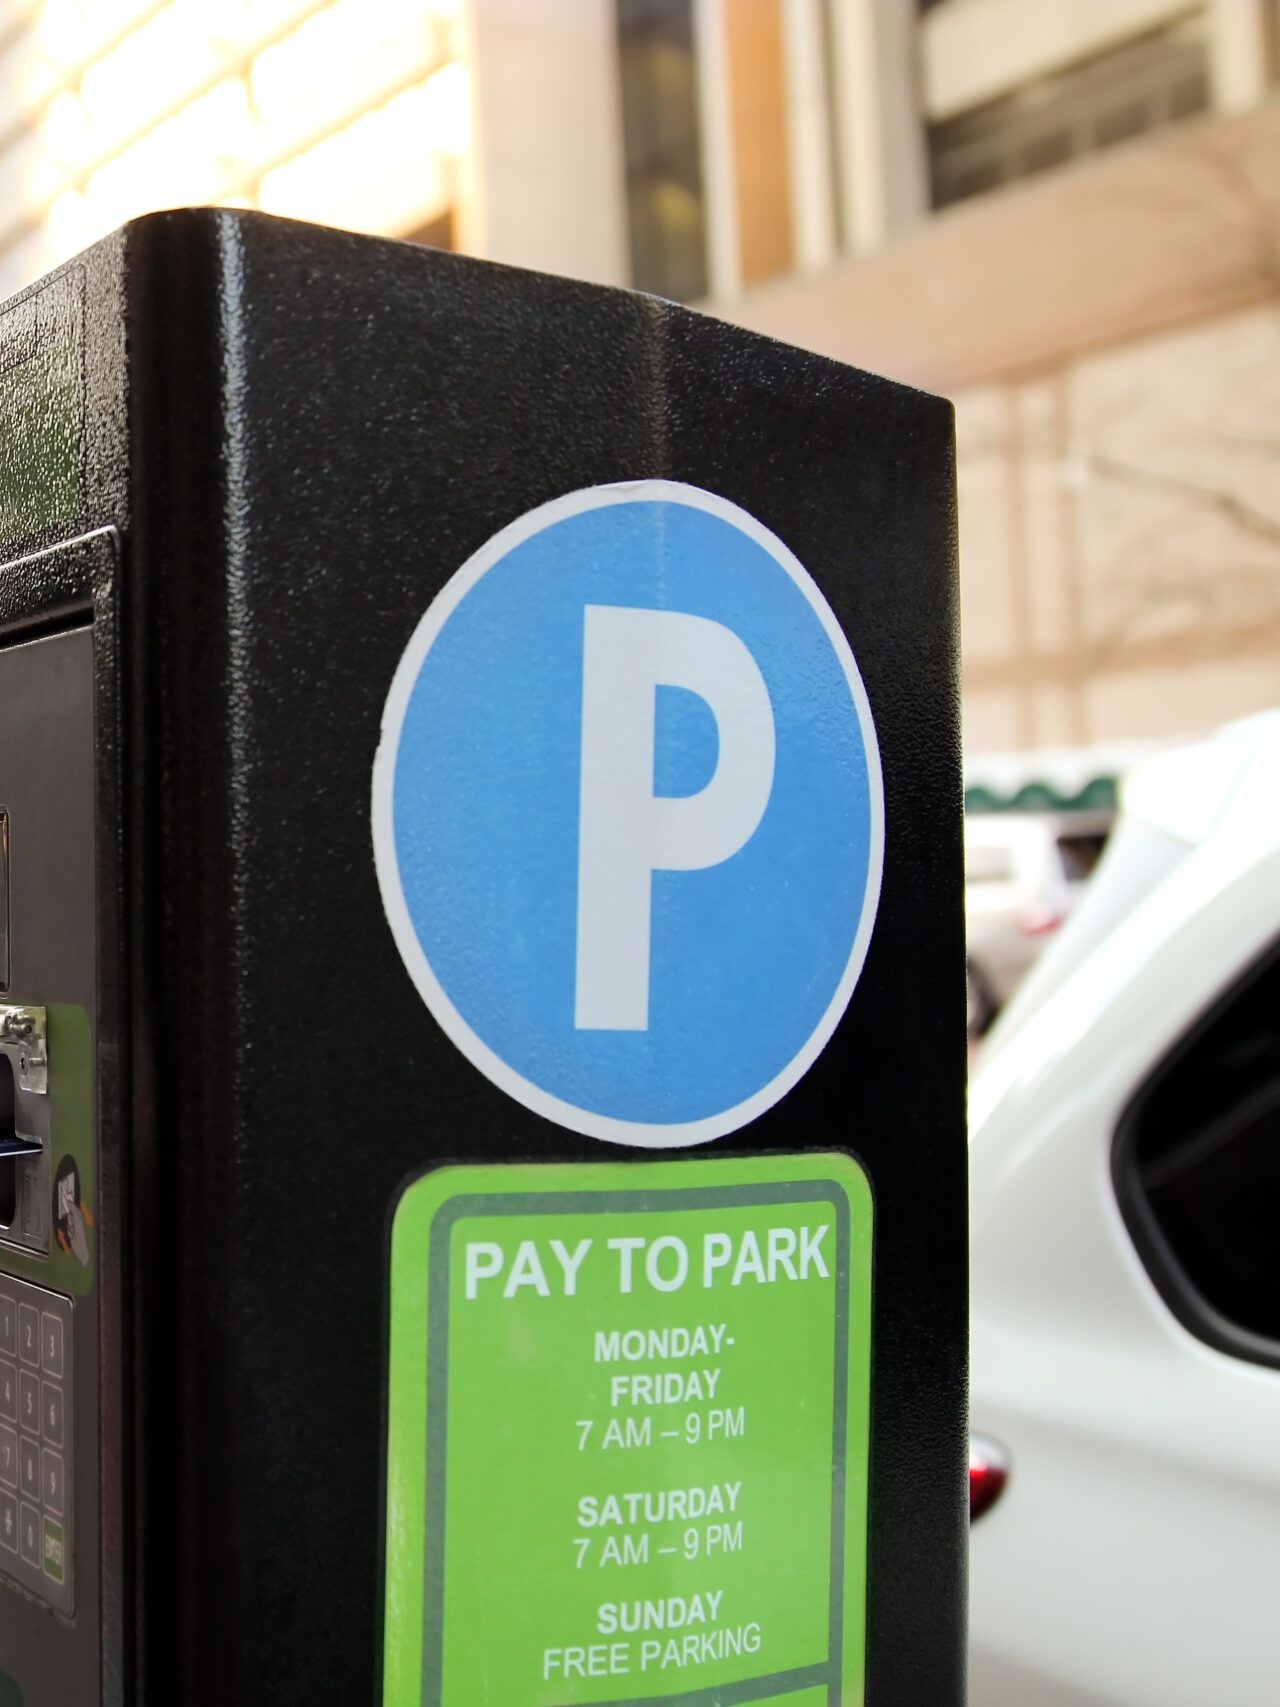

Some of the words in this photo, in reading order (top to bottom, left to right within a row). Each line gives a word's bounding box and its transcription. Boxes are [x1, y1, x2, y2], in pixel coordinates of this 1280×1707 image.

[574, 604, 776, 1031] P
[465, 1239, 593, 1300] PAY
[607, 1236, 689, 1294] TO
[703, 1224, 831, 1289] PARK
[594, 1323, 736, 1363] MONDAY-
[611, 1368, 722, 1407] FRIDAY
[576, 1420, 594, 1451] 7
[602, 1417, 652, 1450] AM
[685, 1412, 702, 1445] 9
[708, 1406, 746, 1441] PM
[577, 1480, 743, 1529] SATURDAY
[573, 1537, 591, 1569] 7
[599, 1533, 650, 1567] AM
[683, 1527, 701, 1561] 9
[706, 1520, 744, 1556] PM
[596, 1589, 724, 1635] SUNDAY
[542, 1642, 631, 1680] FREE
[641, 1622, 762, 1671] PARKING
